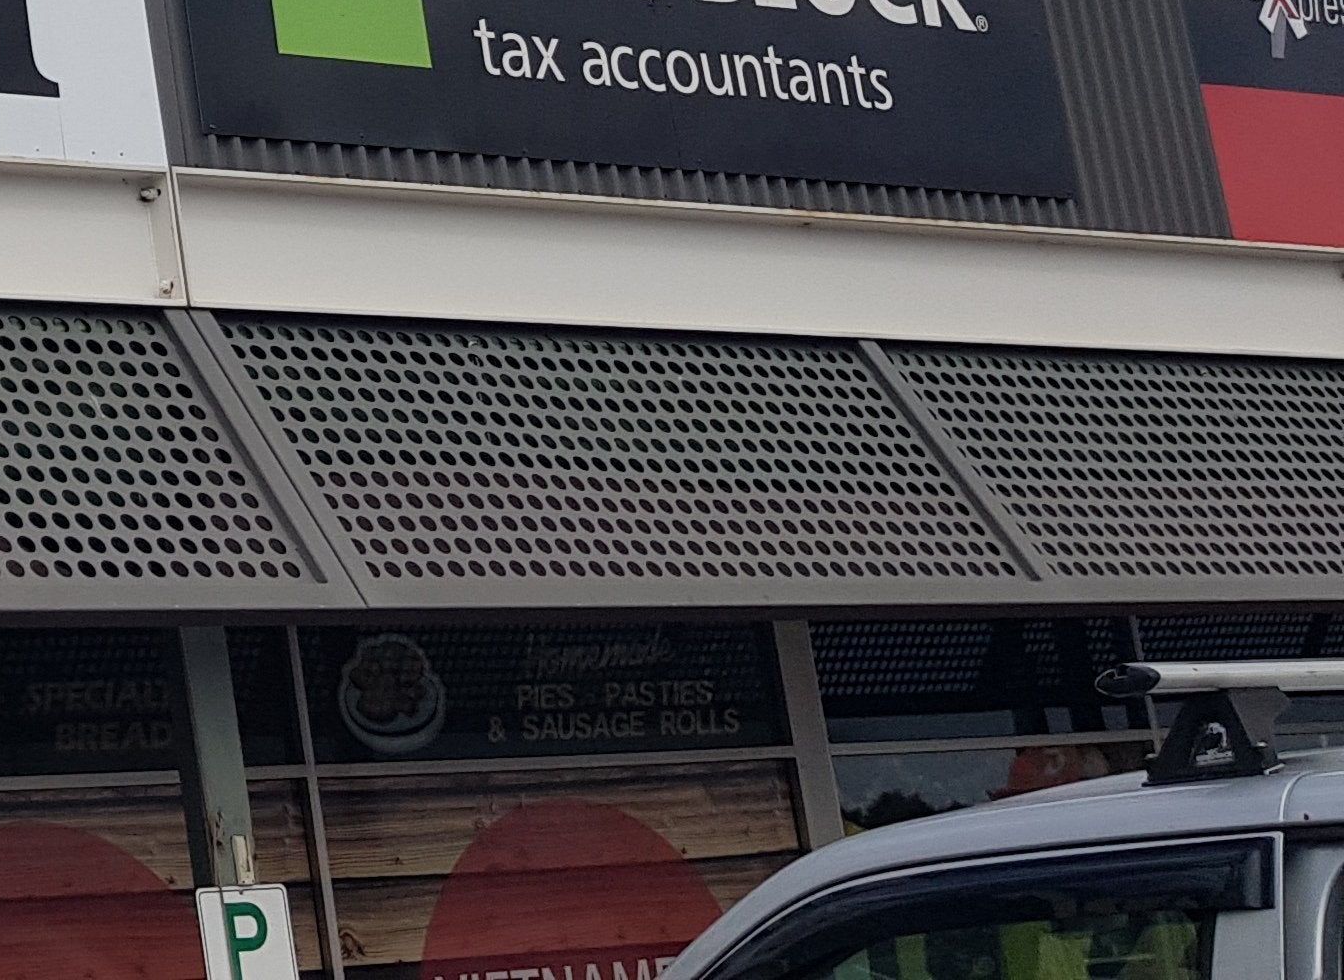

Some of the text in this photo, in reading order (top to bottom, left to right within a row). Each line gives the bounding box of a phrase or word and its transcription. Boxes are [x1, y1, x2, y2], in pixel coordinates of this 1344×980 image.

[473, 18, 894, 112] tax accountants
[515, 679, 715, 710] PIES PASTIES
[55, 721, 172, 751] BREAD
[488, 708, 741, 742] & SAUSAGE ROLLS
[223, 901, 268, 980] P
